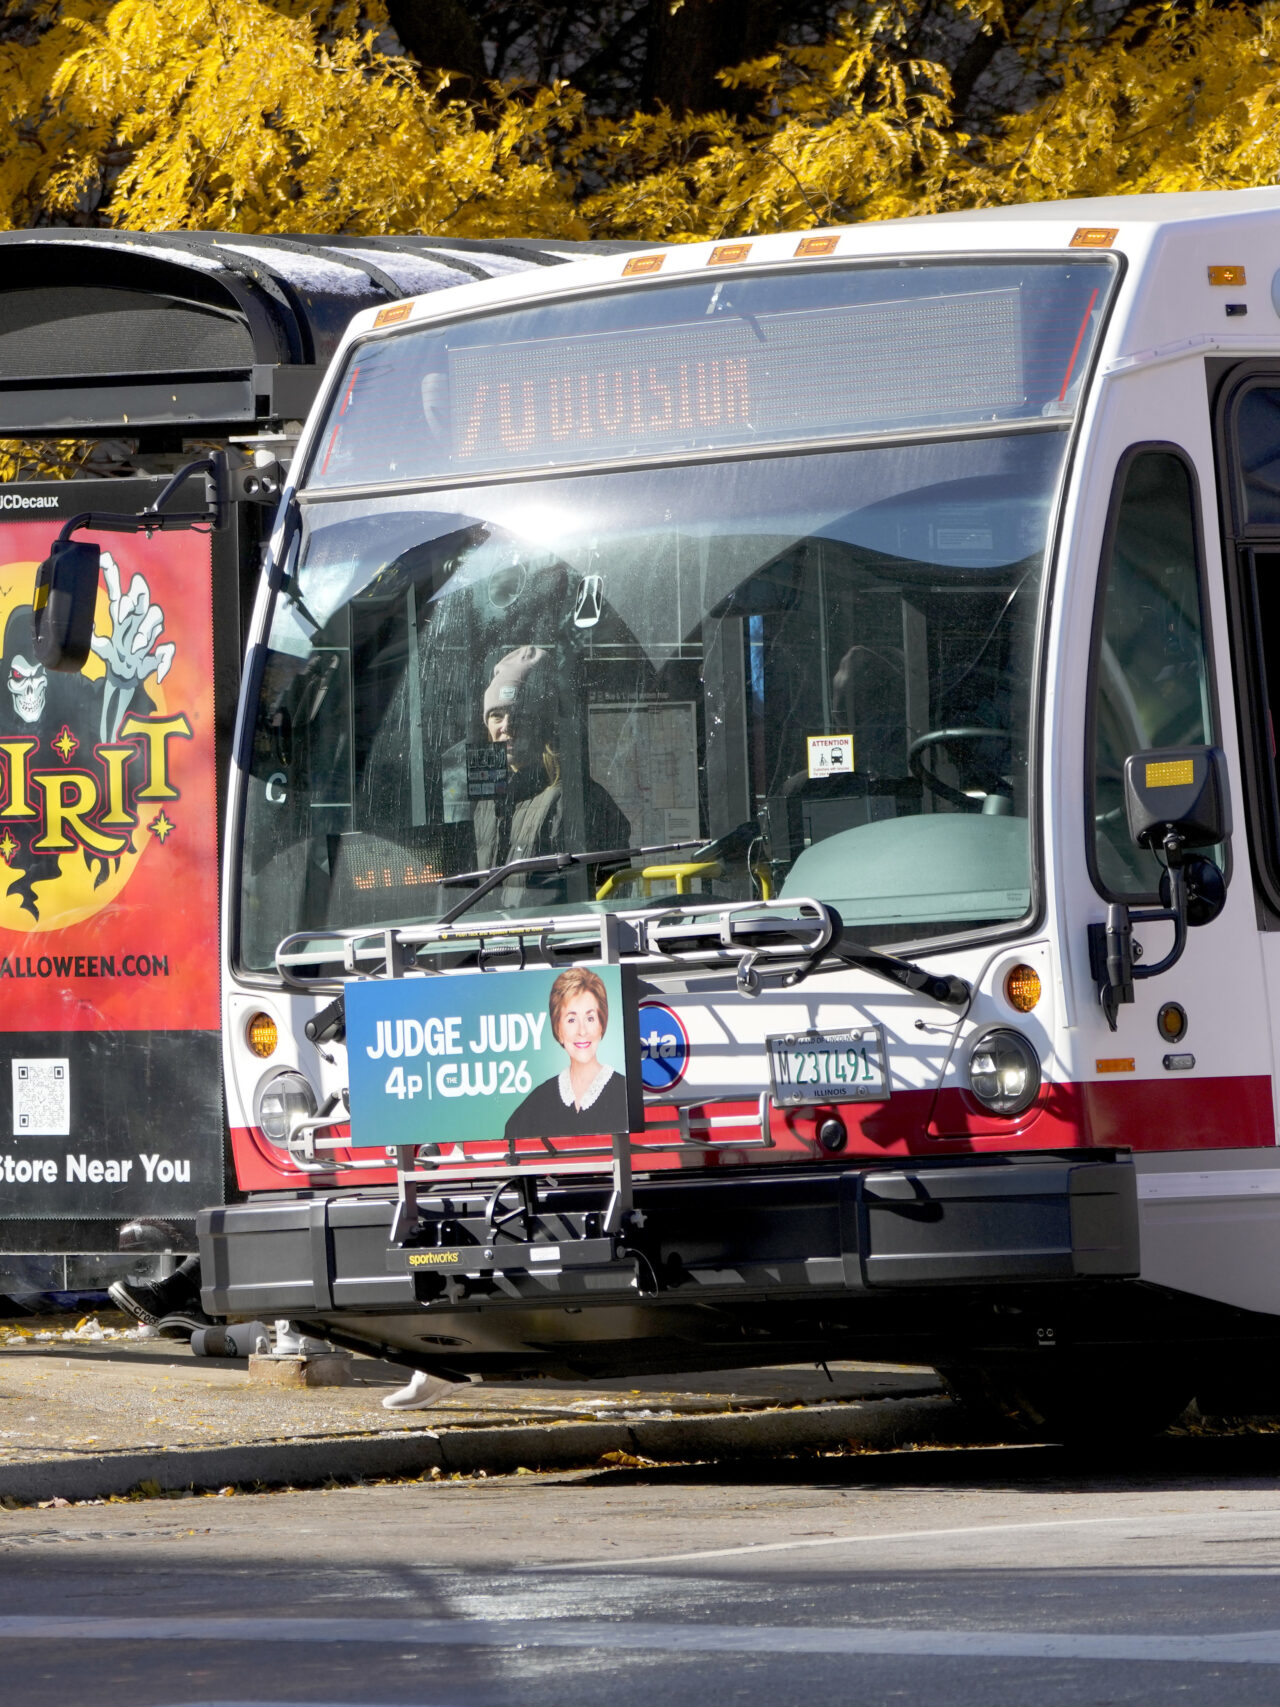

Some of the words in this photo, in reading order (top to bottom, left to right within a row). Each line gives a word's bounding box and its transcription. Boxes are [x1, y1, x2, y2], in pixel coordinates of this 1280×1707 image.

[812, 739, 849, 747] ATTENTION
[366, 1016, 462, 1059] JUDGE
[469, 1012, 547, 1054] JUDY
[794, 1047, 874, 1085] 237491
[814, 1088, 847, 1097] ILLINOIS
[65, 1154, 132, 1183] Near
[139, 1154, 190, 1182] You
[408, 1251, 459, 1267] sportworks
